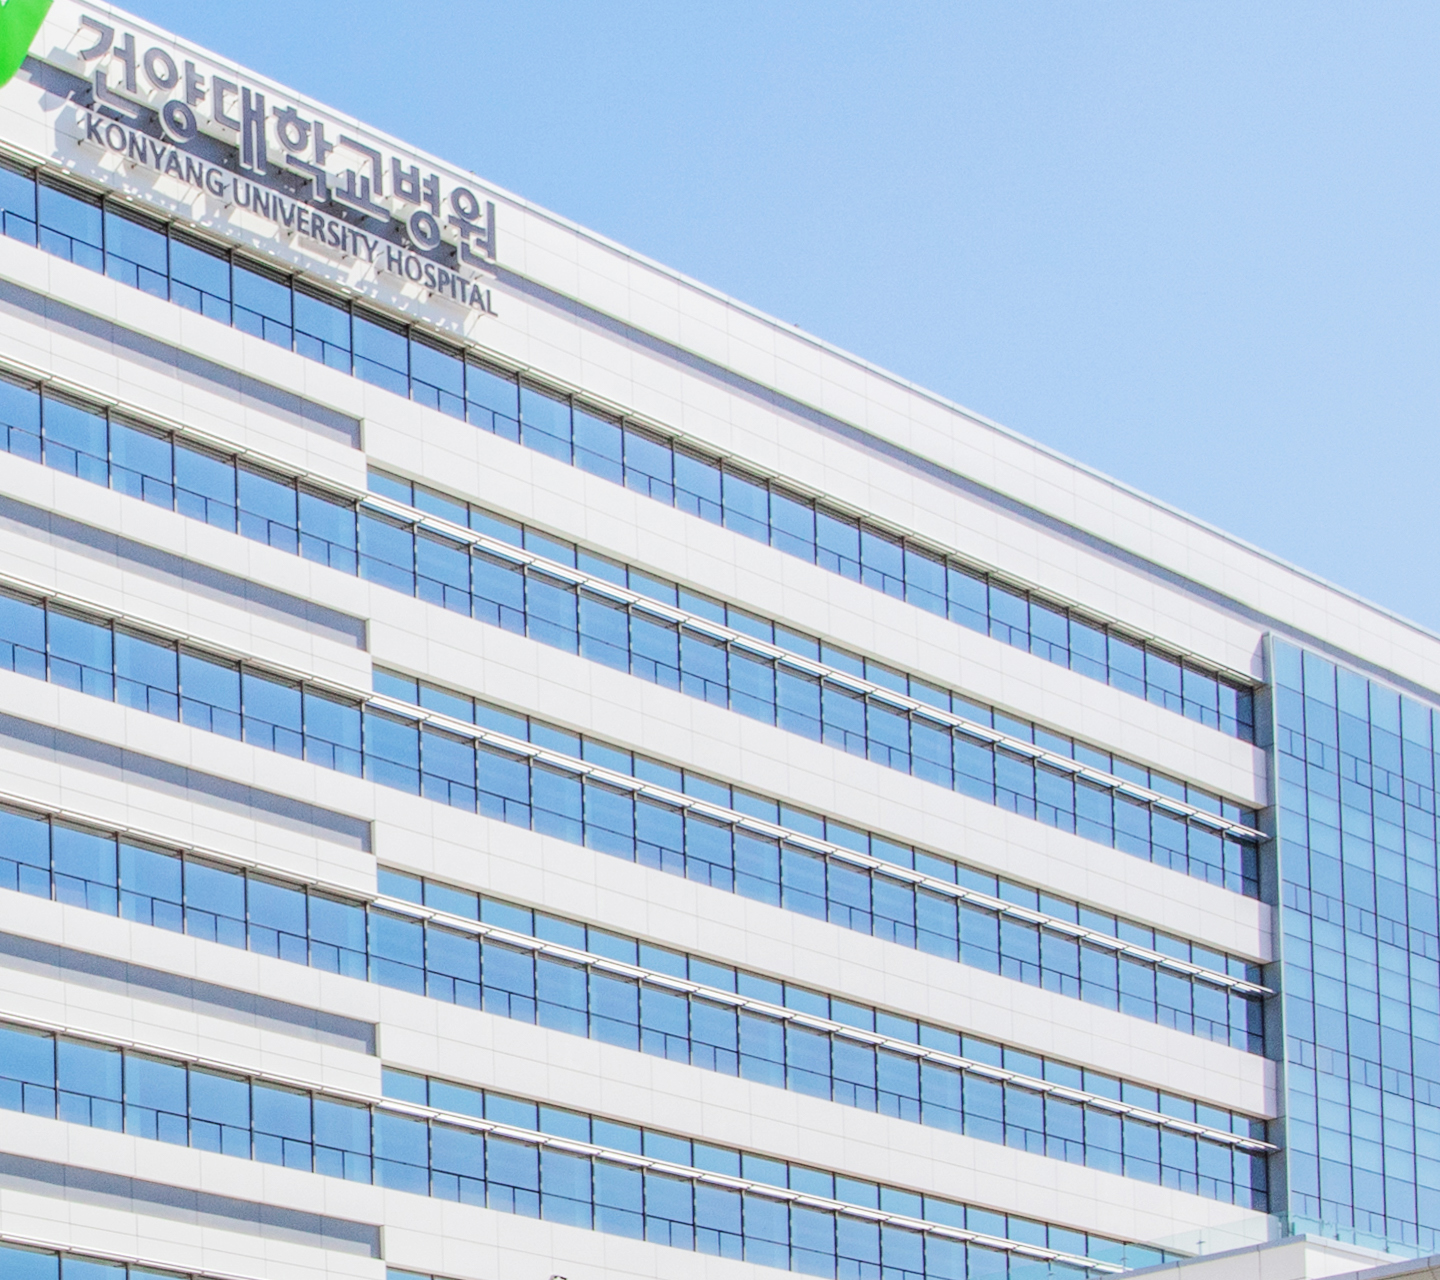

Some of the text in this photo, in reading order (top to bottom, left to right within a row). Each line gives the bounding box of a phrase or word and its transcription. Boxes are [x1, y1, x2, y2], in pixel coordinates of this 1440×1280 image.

[79, 14, 499, 280] 건양대학교병원
[86, 118, 499, 318] KONYANG UNIVERSITY HOSPITAL
